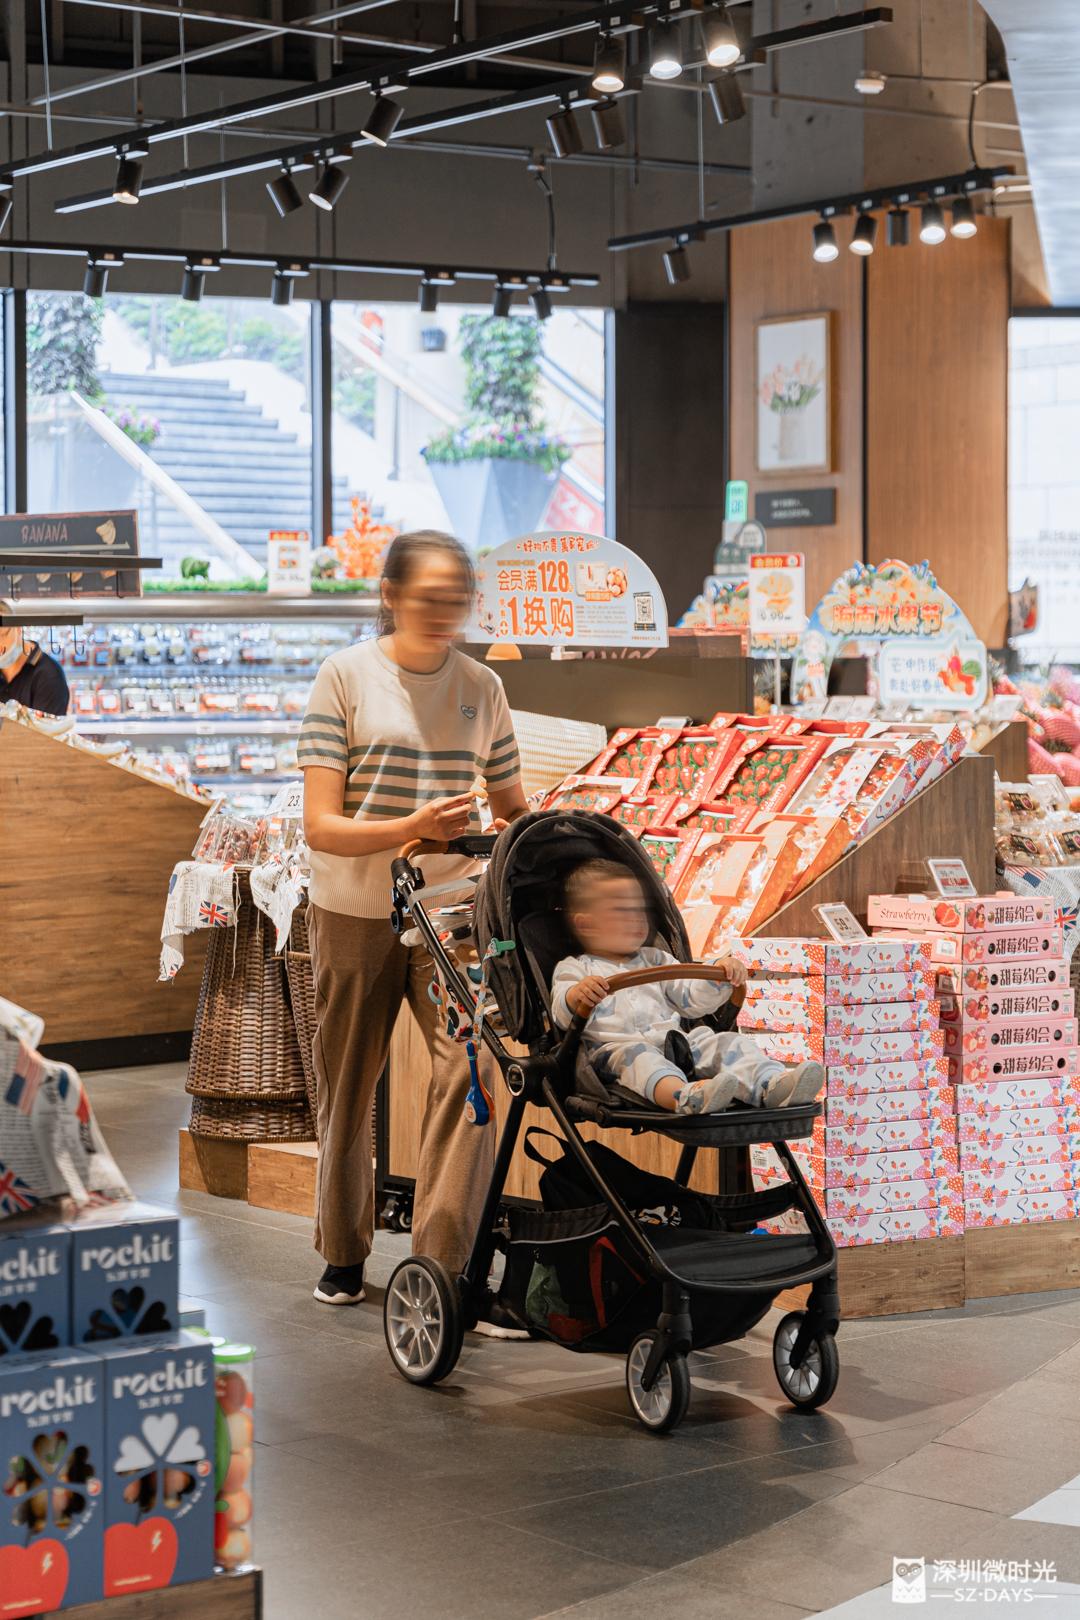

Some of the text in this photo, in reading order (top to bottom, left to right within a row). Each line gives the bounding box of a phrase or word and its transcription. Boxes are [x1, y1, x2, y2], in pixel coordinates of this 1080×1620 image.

[21, 521, 68, 544] BANANA
[994, 905, 1035, 925] 甜莓约会
[995, 936, 1039, 956] 甜莓约会
[999, 966, 1048, 987] 甜莓约会
[1000, 995, 1050, 1016] 甜莓约会
[1000, 1025, 1050, 1046] 甜莓约会
[1002, 1053, 1054, 1074] 甜莓约会
[81, 1234, 174, 1272] rockit
[0, 1247, 61, 1281] ckit
[113, 1360, 207, 1399] rockit
[0, 1375, 98, 1417] rockit
